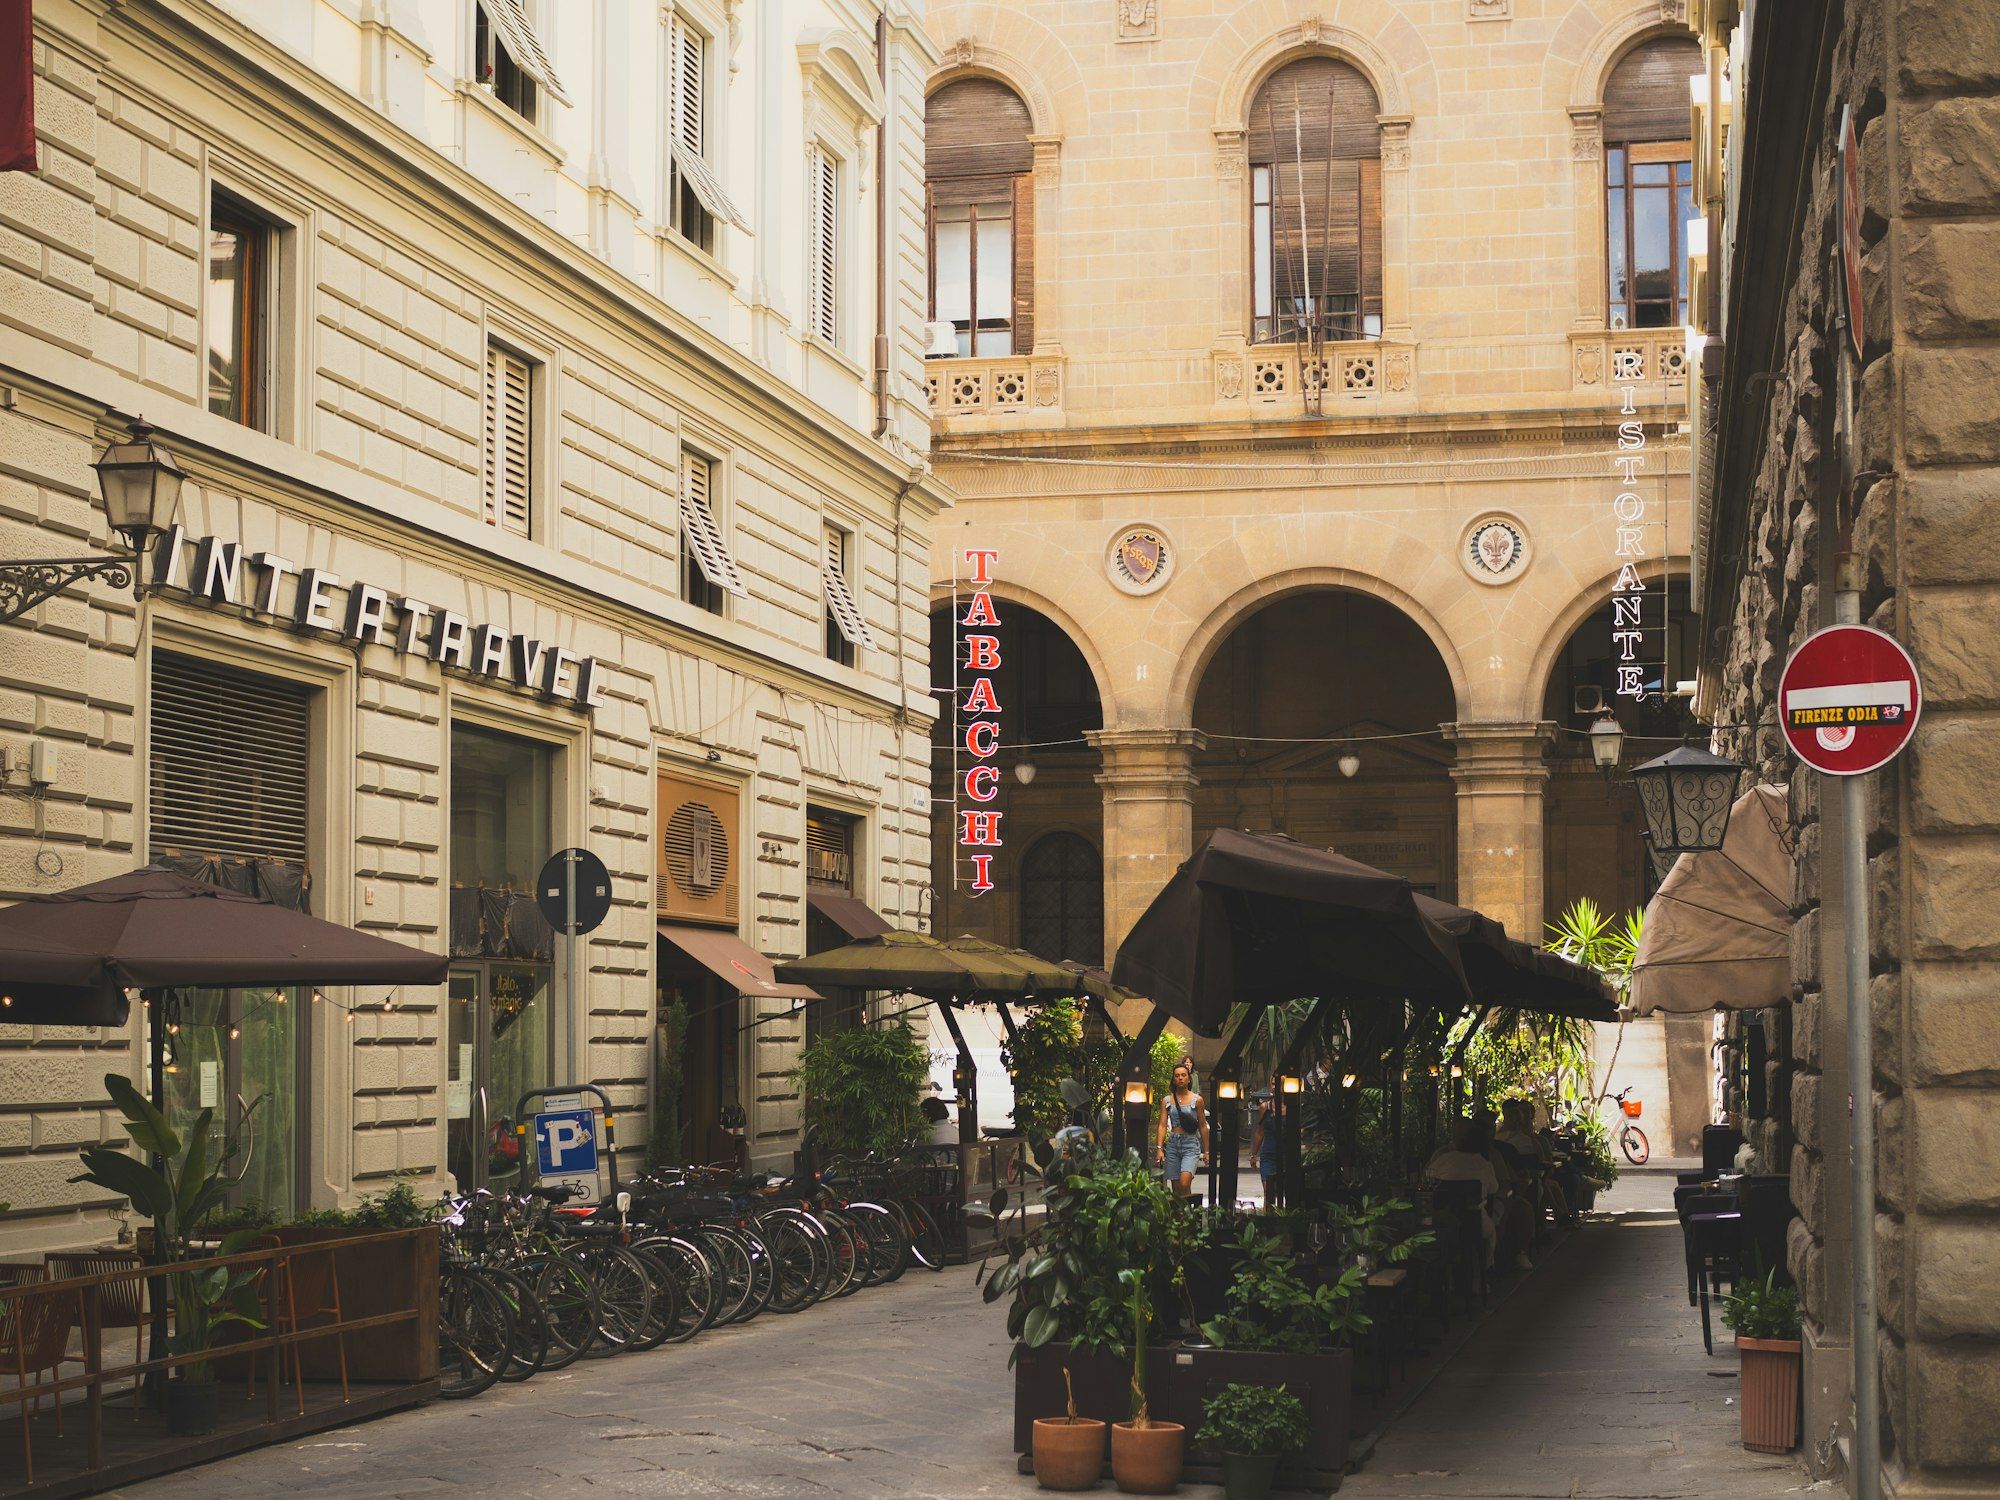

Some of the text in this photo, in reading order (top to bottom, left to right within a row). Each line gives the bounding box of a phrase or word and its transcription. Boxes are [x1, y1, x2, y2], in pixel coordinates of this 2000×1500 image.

[1130, 548, 1154, 571] SPQR
[1613, 353, 1647, 696] RISTORANTE
[155, 524, 606, 707] INTERTRAVEL
[960, 549, 1002, 892] TABACCHI
[1794, 706, 1878, 724] FIRENZE ODIA
[547, 1119, 583, 1167] P
